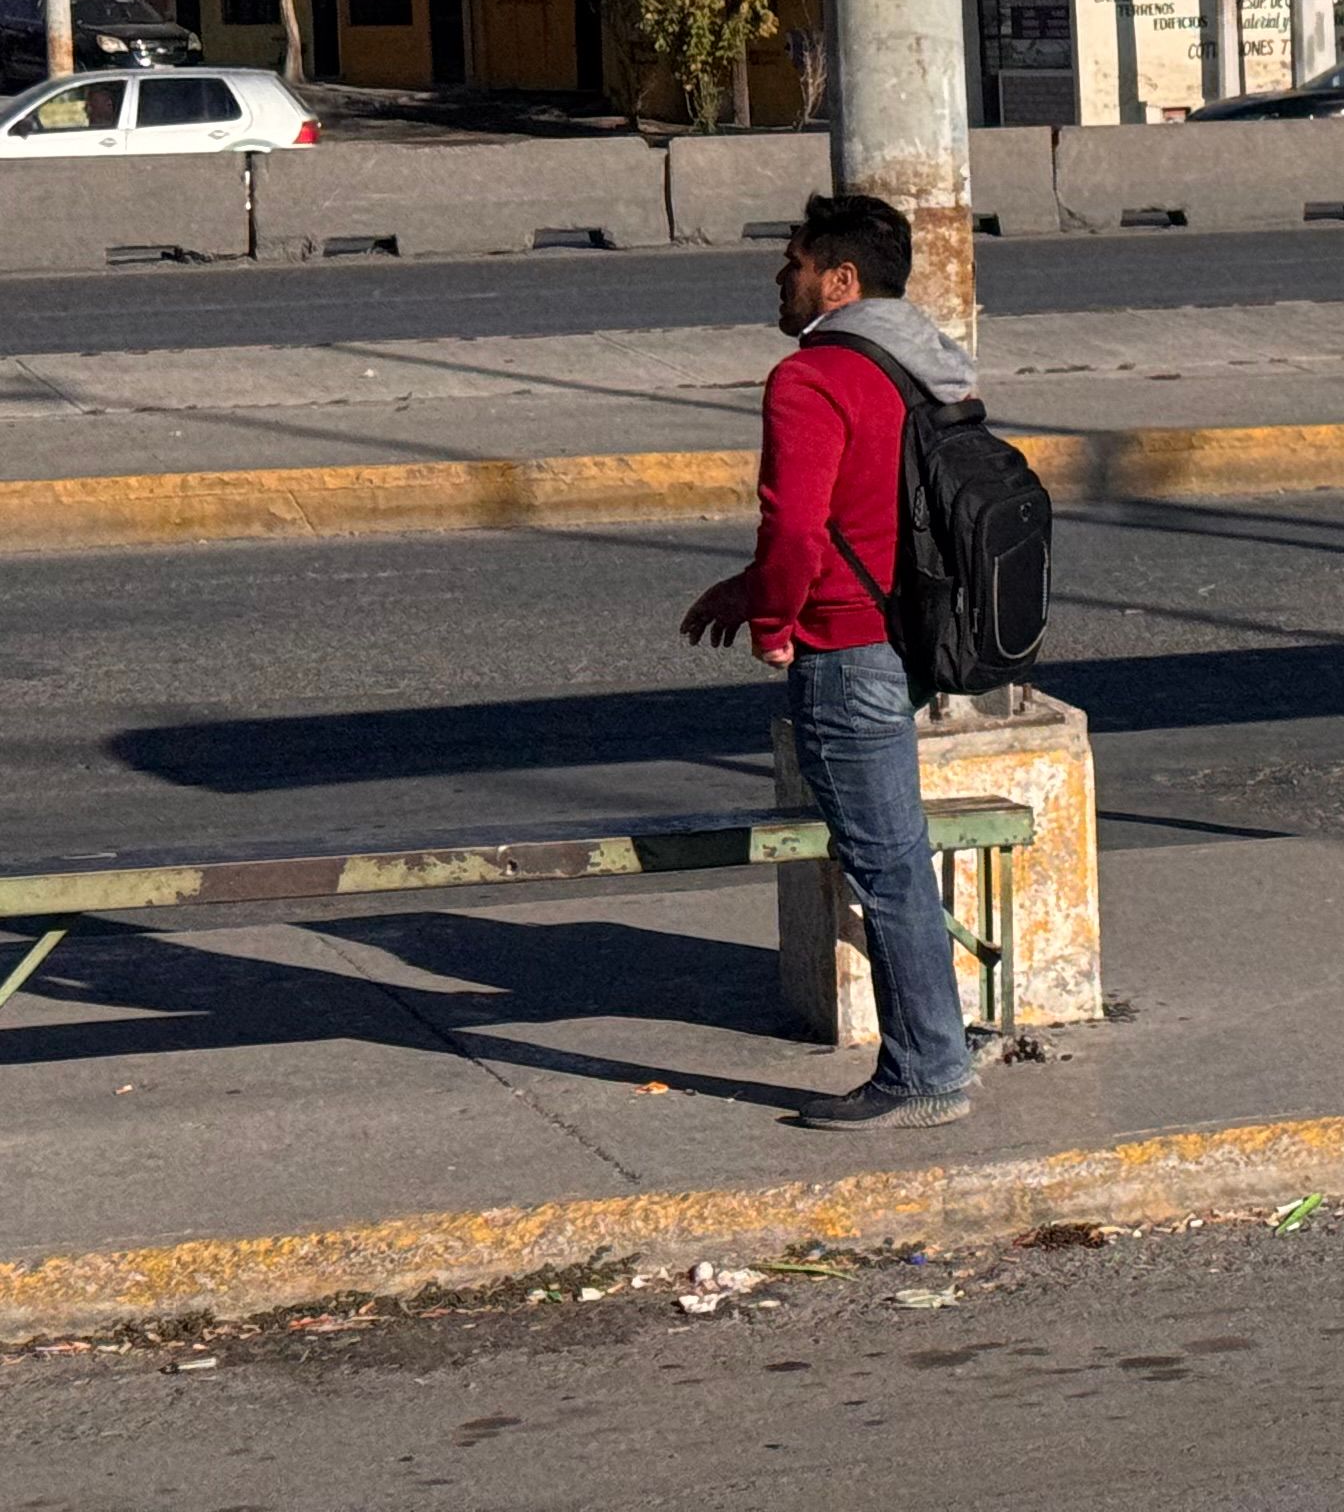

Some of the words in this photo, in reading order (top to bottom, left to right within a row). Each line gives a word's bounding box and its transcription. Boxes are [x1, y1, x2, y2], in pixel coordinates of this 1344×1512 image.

[1118, 2, 1175, 17] TERRENOS
[1153, 15, 1209, 31] EDIFICIOS
[1242, 12, 1280, 30] aterial
